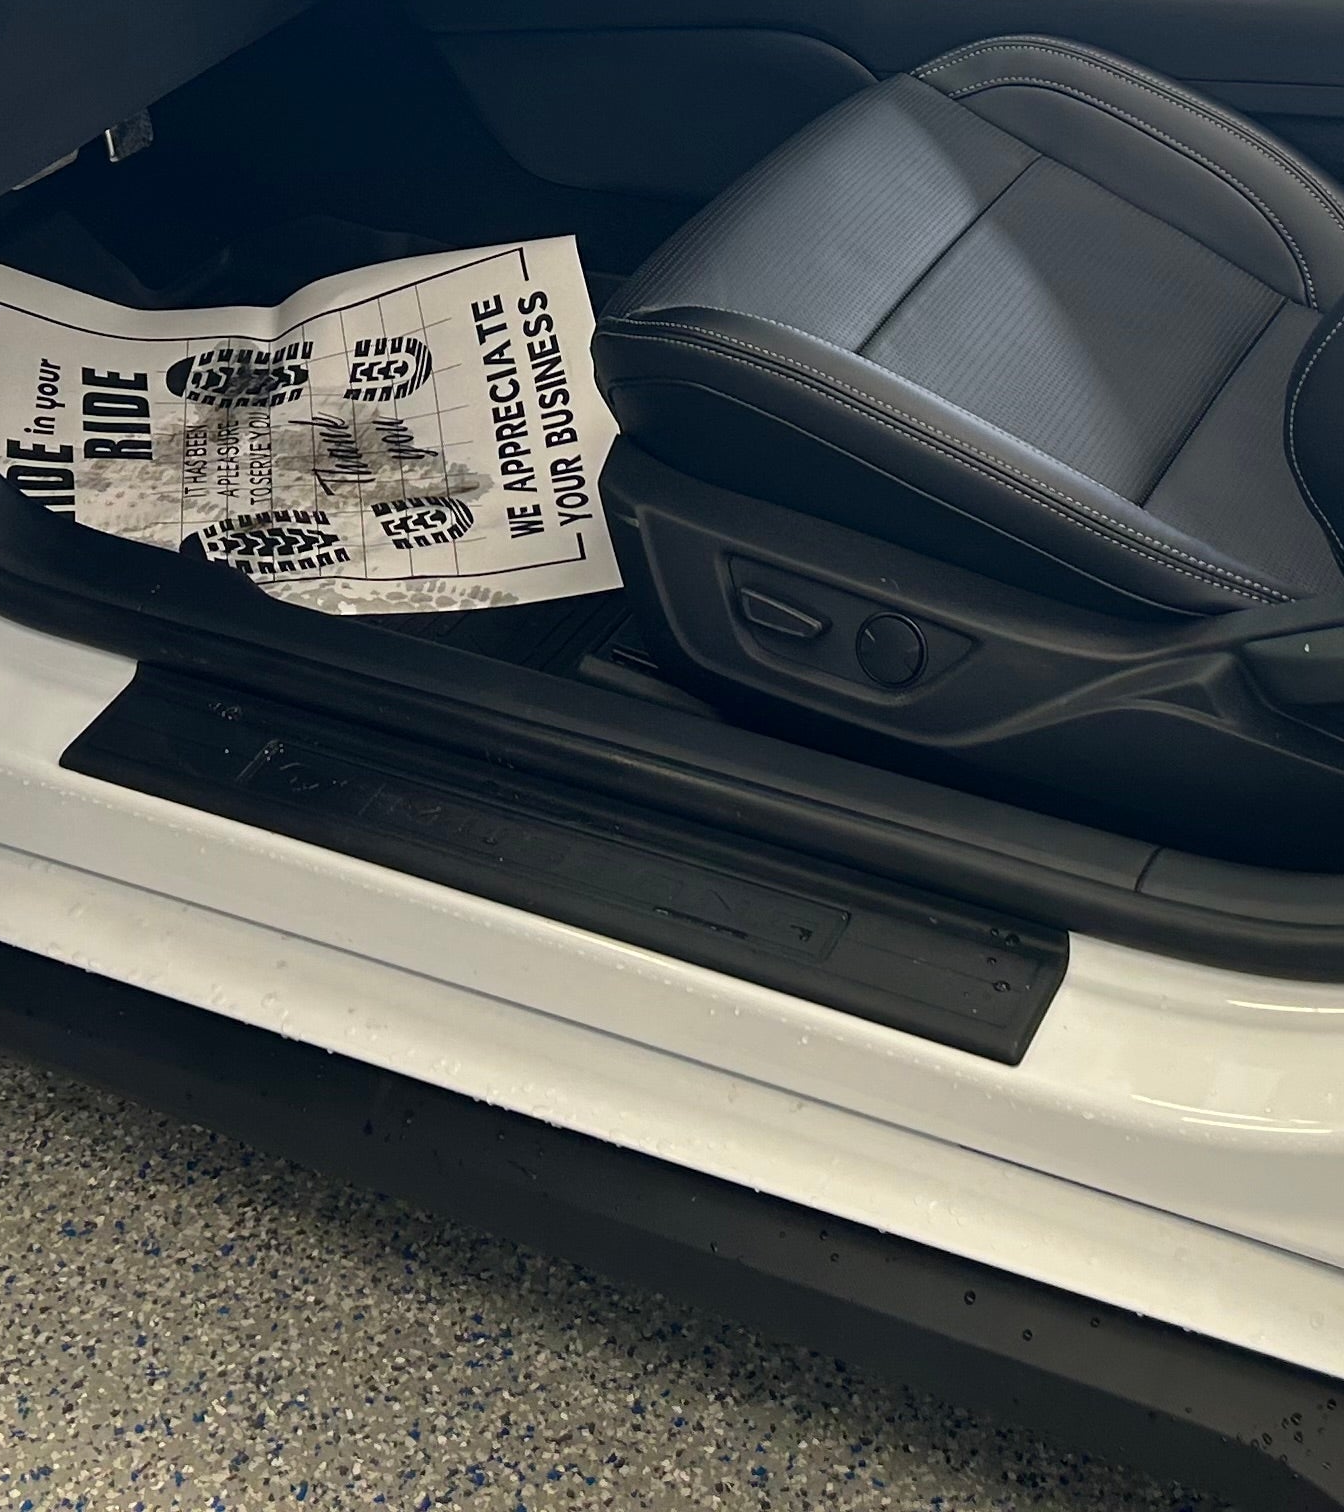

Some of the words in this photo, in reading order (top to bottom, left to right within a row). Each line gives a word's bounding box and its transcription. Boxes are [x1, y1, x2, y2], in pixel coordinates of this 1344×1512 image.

[36, 358, 66, 409] your
[517, 290, 578, 448] BUSINESS
[82, 367, 154, 460] RIDE
[471, 294, 538, 493] APPRECIATE
[24, 416, 56, 435] in
[185, 424, 208, 457] BEEN
[249, 411, 271, 440] YOU
[372, 416, 438, 459] you
[184, 461, 208, 484] HAS
[217, 420, 240, 486] PLEASURE
[249, 443, 272, 485] SERVE
[288, 411, 376, 497] Thank
[6, 439, 76, 523] IDE
[184, 487, 208, 498] IT
[250, 488, 272, 505] TO
[550, 454, 593, 526] YOUR
[507, 503, 545, 539] WE
